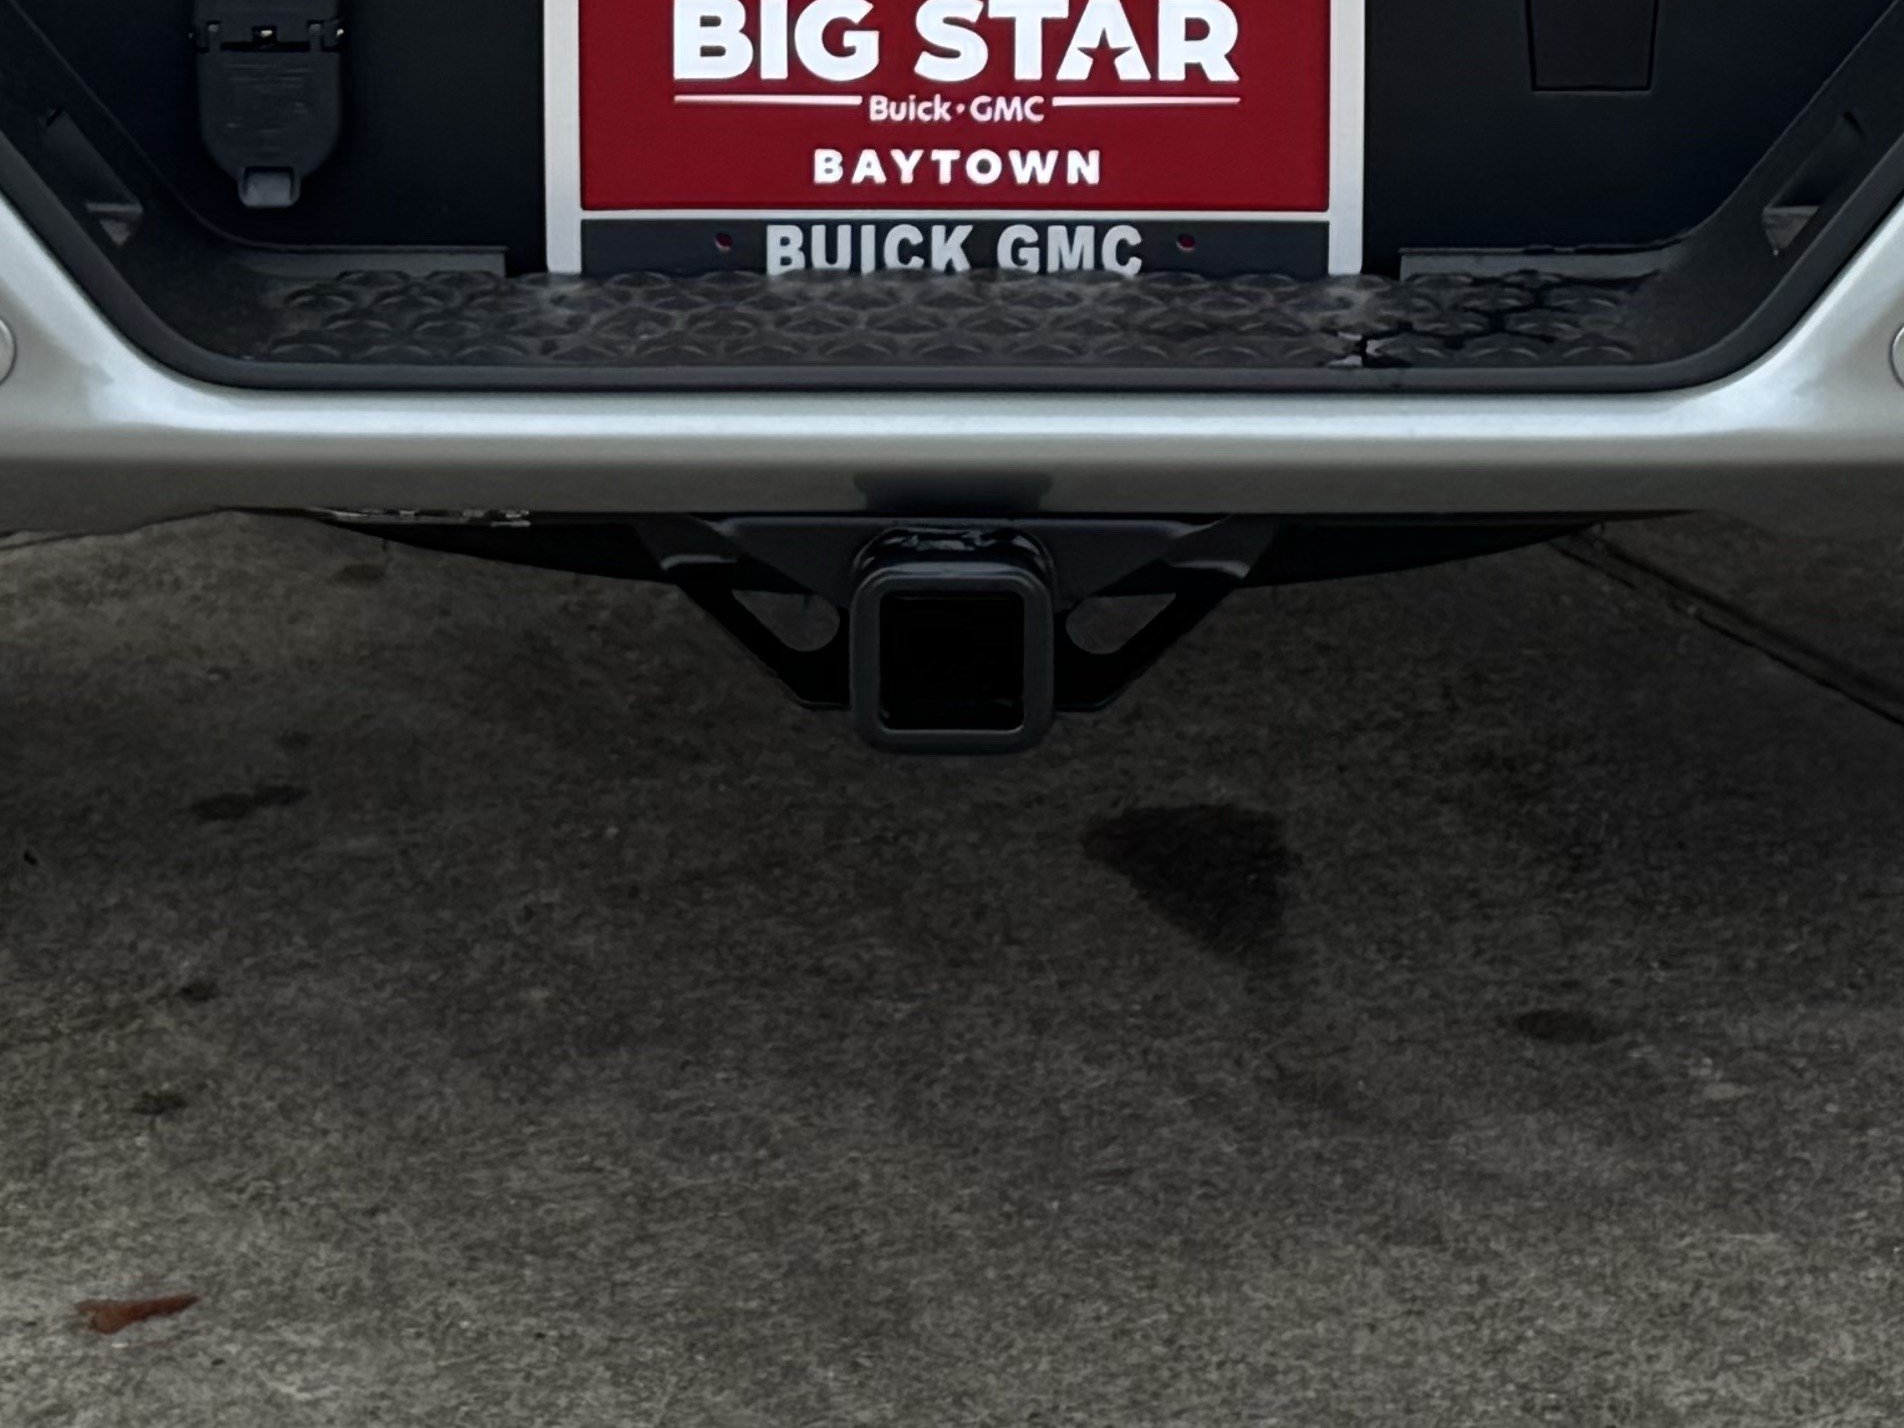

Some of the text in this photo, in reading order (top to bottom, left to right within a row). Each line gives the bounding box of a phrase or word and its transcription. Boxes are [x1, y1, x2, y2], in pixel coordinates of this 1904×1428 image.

[813, 148, 1101, 186] BAYTOWN
[765, 223, 1144, 276] BUICK GMC
